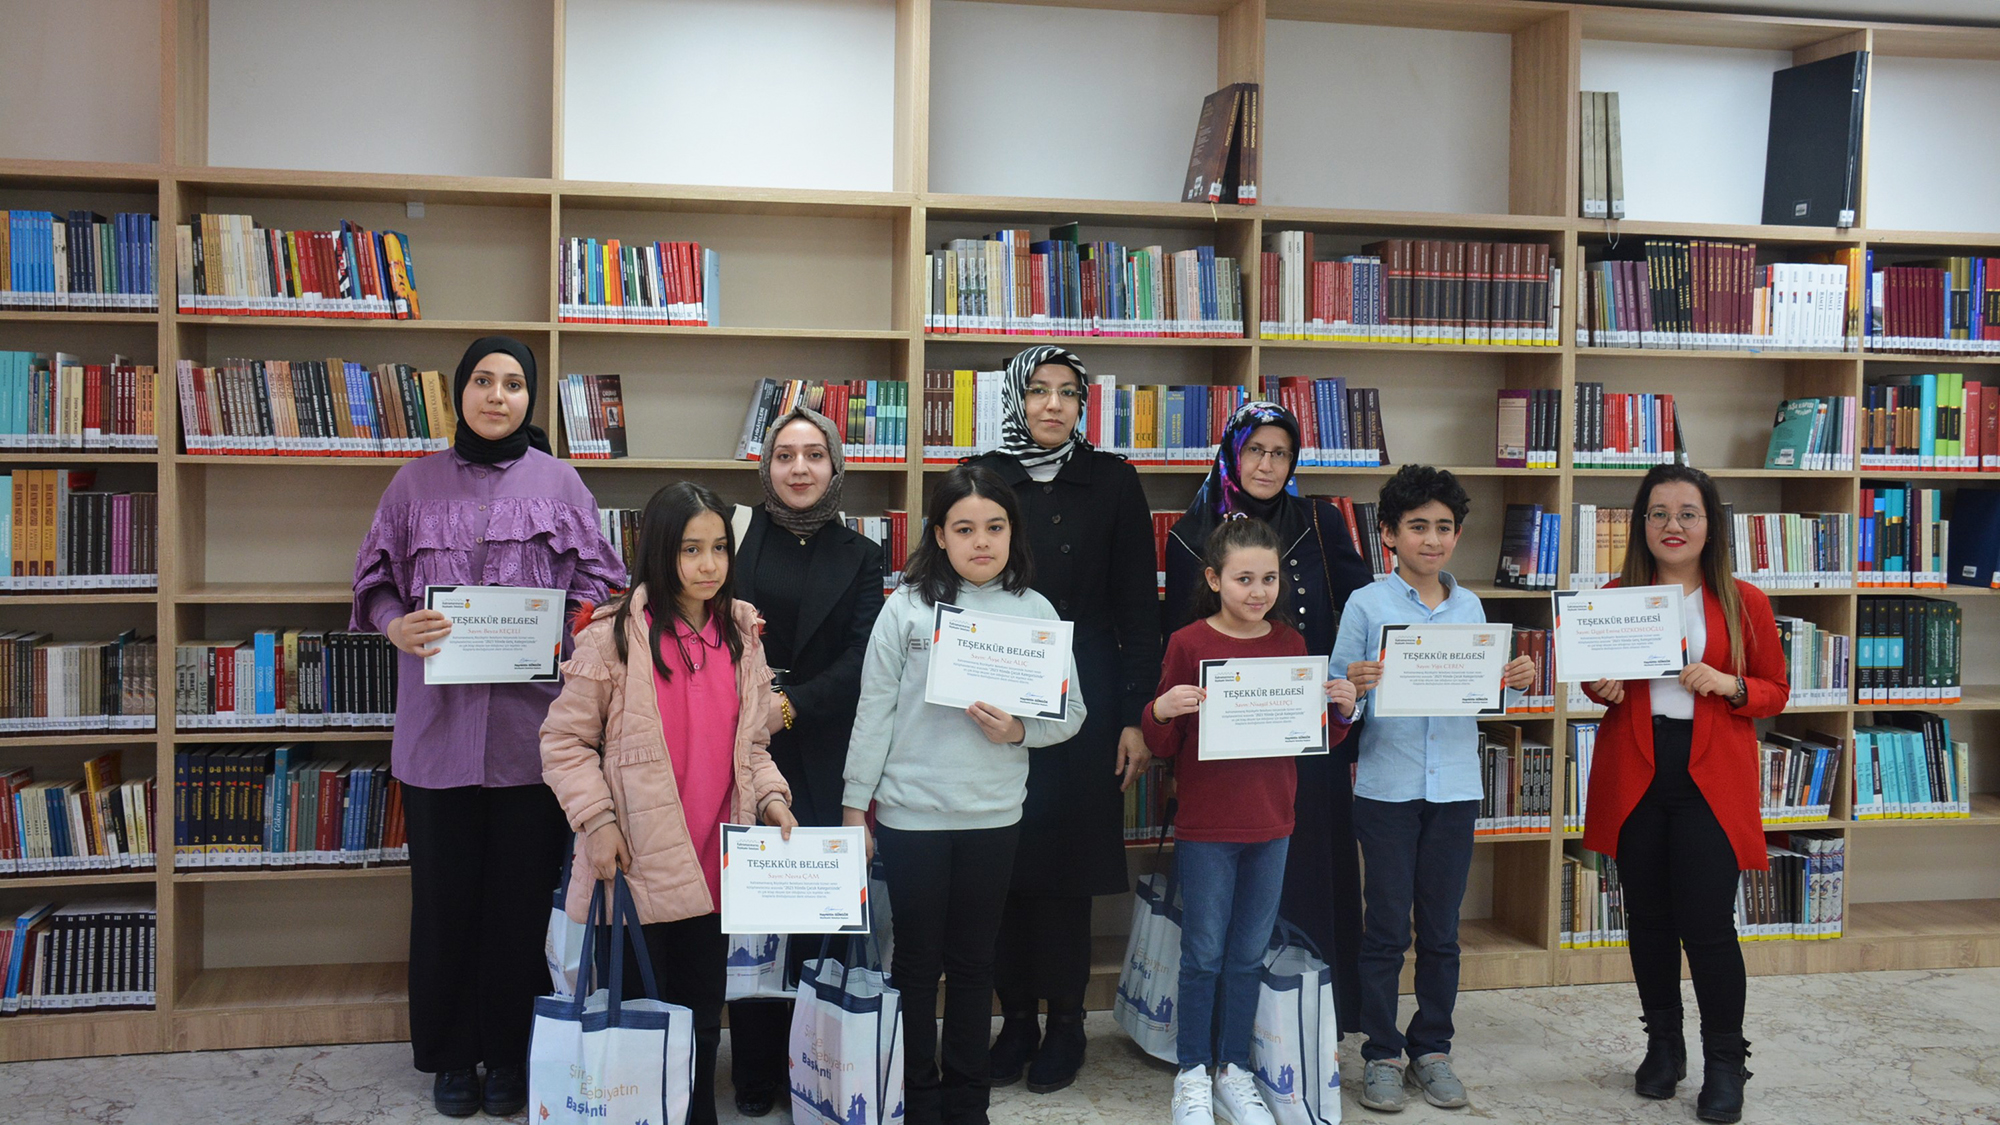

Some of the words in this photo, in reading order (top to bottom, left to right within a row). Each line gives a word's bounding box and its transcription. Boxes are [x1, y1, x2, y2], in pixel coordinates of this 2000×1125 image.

[451, 615, 499, 625] TEŞEKKÜR
[501, 616, 538, 625] BELGESİ
[1577, 615, 1622, 626] TEŞEKKÜR
[1624, 613, 1661, 624] BELGESİ
[957, 638, 1004, 653] TEŞEKKÜR
[1007, 647, 1045, 659] BELGESİ
[1403, 651, 1448, 661] TEŞEKKÜR
[1450, 651, 1485, 660] BELGESİ
[199, 681, 207, 706] ŞUBAT
[1223, 688, 1268, 699] TEŞEKKÜR
[1269, 686, 1304, 696] BELGESİ
[747, 859, 797, 869] TEŞEKKÜR
[799, 859, 839, 869] BELGESİ
[802, 1052, 832, 1080] Başknti
[566, 1096, 607, 1118] Başknti
